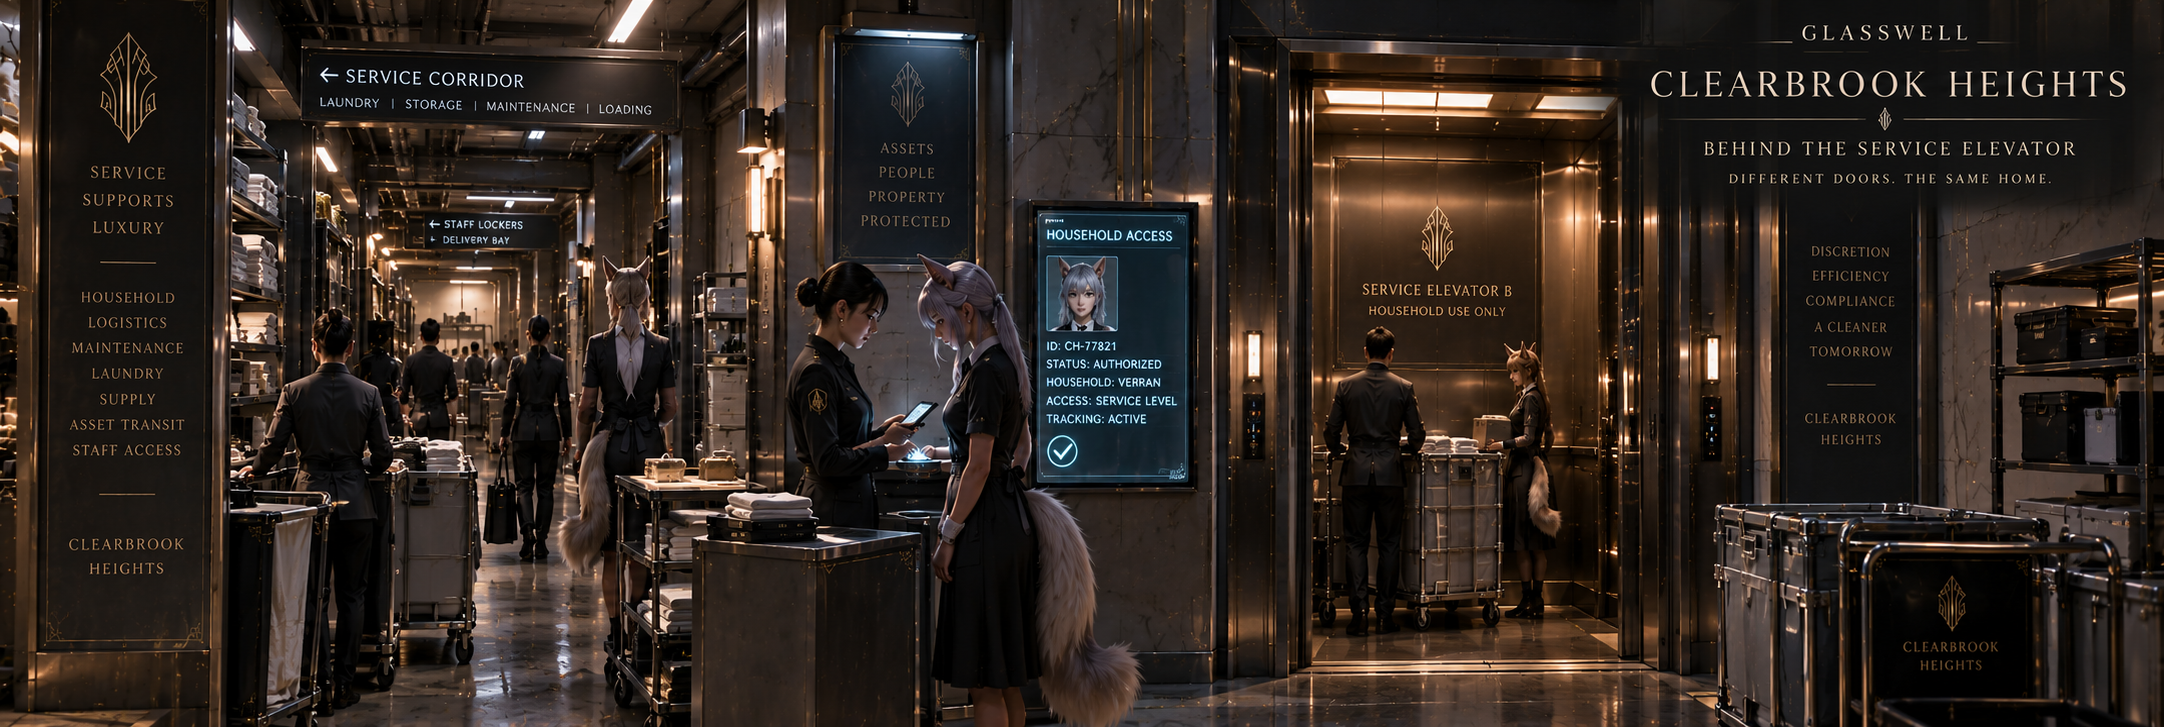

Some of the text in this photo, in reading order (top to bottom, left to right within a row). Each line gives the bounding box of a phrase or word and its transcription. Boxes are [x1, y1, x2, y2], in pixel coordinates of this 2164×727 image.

[345, 68, 525, 89] SERVICE CORRIDOR
[319, 96, 652, 116] LAUNDRY STORAGE MAINTENANCE LOADING
[880, 142, 934, 155] ASSETS
[90, 165, 166, 180] SERVICE
[879, 166, 935, 180] PEOPLE
[82, 193, 174, 208] SUPPORTS
[868, 190, 945, 203] PROPERTY
[93, 220, 164, 235] LUXURY
[444, 219, 524, 230] STAFF LOCKERS
[861, 214, 951, 228] PROTECTED
[442, 235, 510, 245] DELIVERY BAY
[1046, 228, 1173, 242] HOUSEHOLD ACCESS
[1811, 245, 1890, 258] DISCRETION
[1812, 269, 1890, 283] EFFICIENCY
[1362, 282, 1513, 297] SERVICE ELEVATOR B
[81, 291, 175, 304] HOUSEHOLD
[1805, 294, 1896, 308] COMPLIANCE
[1368, 305, 1506, 317] HOUSEHOLD USE ONLY
[88, 316, 167, 329] LOGISTICS
[1814, 320, 1888, 333] A CLEANER
[71, 341, 184, 354] MAINTENANCE
[1046, 340, 1116, 352] ID: CH-77821
[1809, 345, 1893, 358] TOMORROW
[1046, 358, 1162, 370] STATUS: AUTHORIZED
[91, 367, 164, 380] LAUNDRY
[1046, 376, 1161, 388] HOUSEHOLD: VERRAN
[99, 393, 156, 406] SUPPLY
[1045, 395, 1178, 407] ACCESS: SERVICE LEVEL
[69, 418, 185, 431] ASSET TRANSIT
[1045, 413, 1147, 425] TRACKING: ACTIVE
[1804, 412, 1897, 424] CLEARBROOK
[1821, 433, 1882, 446] HEIGHTS
[72, 443, 181, 457] STAFF ACCESS
[68, 537, 184, 551] CLEARBROOK
[89, 562, 164, 575] HEIGHTS
[1902, 640, 1999, 653] CLEARBROOK
[1920, 659, 1983, 671] HEIGHTS
